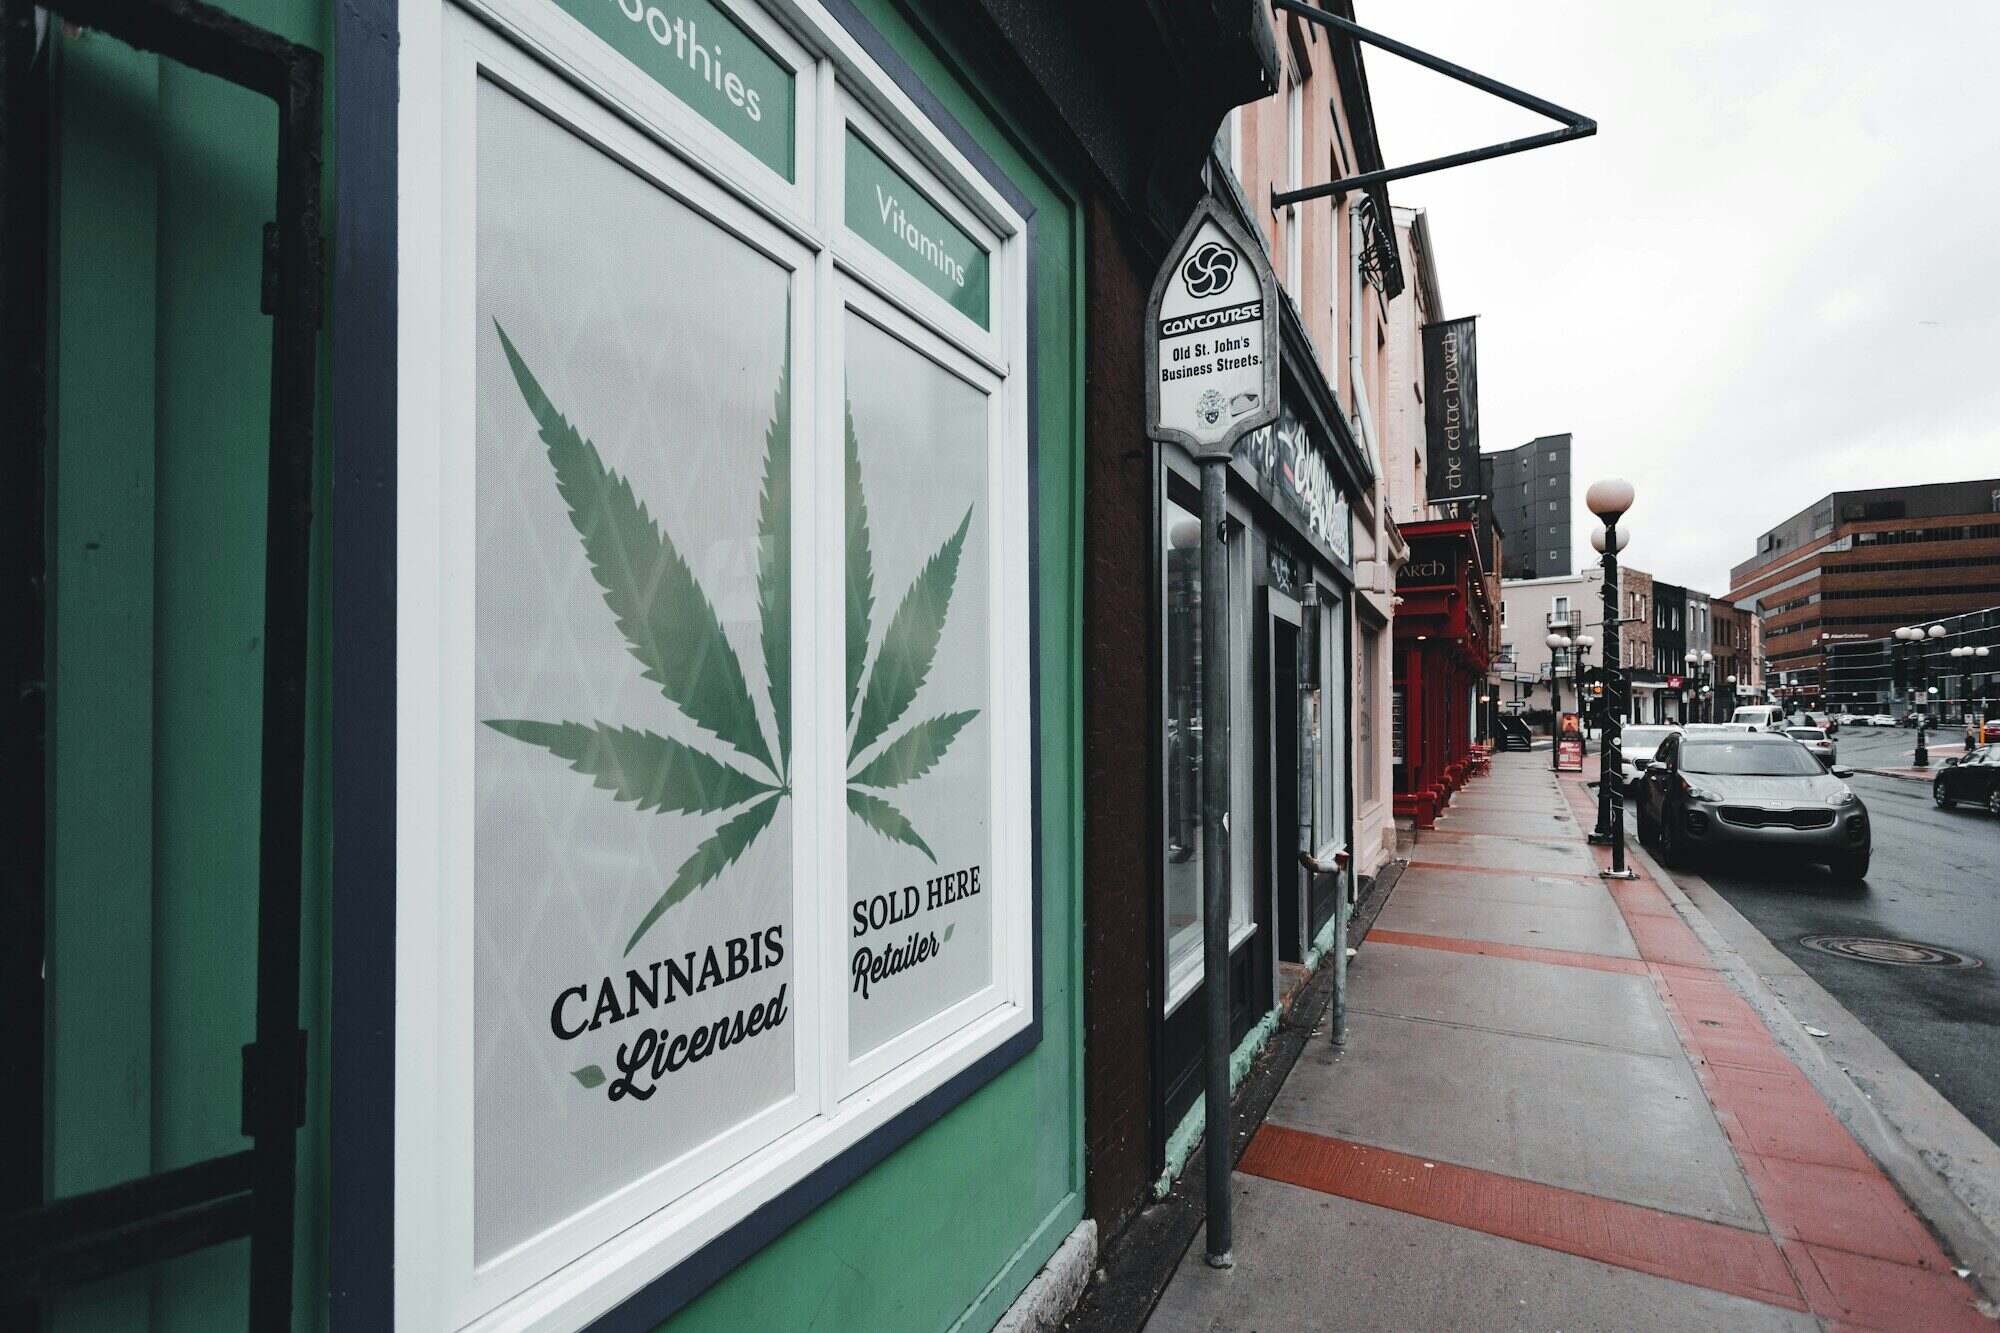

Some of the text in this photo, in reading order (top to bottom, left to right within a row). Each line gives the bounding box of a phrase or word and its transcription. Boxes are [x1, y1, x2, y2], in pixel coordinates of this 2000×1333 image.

[610, 0, 761, 122] oothies
[876, 185, 966, 288] Vitamins
[1162, 304, 1261, 335] CONCOURSE
[1173, 336, 1250, 362] Old St. John's
[1162, 353, 1263, 382] Business Streets.
[852, 865, 981, 938] SOLD HERE
[550, 924, 785, 1041] CANNABIS
[852, 931, 940, 1000] Retailer
[608, 983, 788, 1102] Licensed
